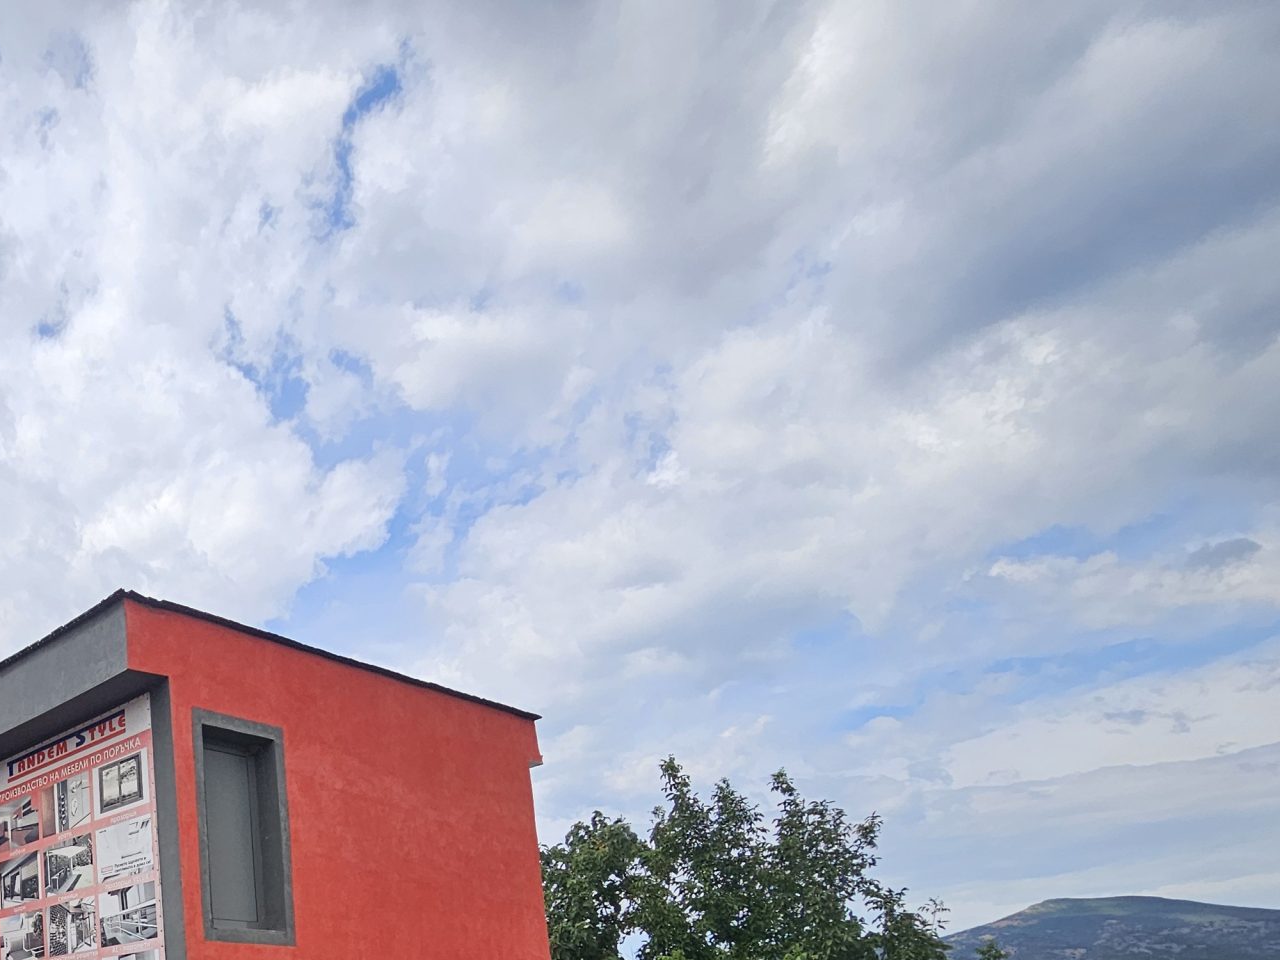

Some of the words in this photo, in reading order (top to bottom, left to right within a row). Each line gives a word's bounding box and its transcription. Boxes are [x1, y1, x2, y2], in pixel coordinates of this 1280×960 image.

[6, 739, 68, 777] TANDEM
[75, 713, 126, 747] STYLE
[49, 771, 60, 782] НА
[61, 759, 89, 778] МЕБЕЛИ
[90, 753, 102, 766] ПО
[103, 737, 141, 760] ПОРЪЧКА
